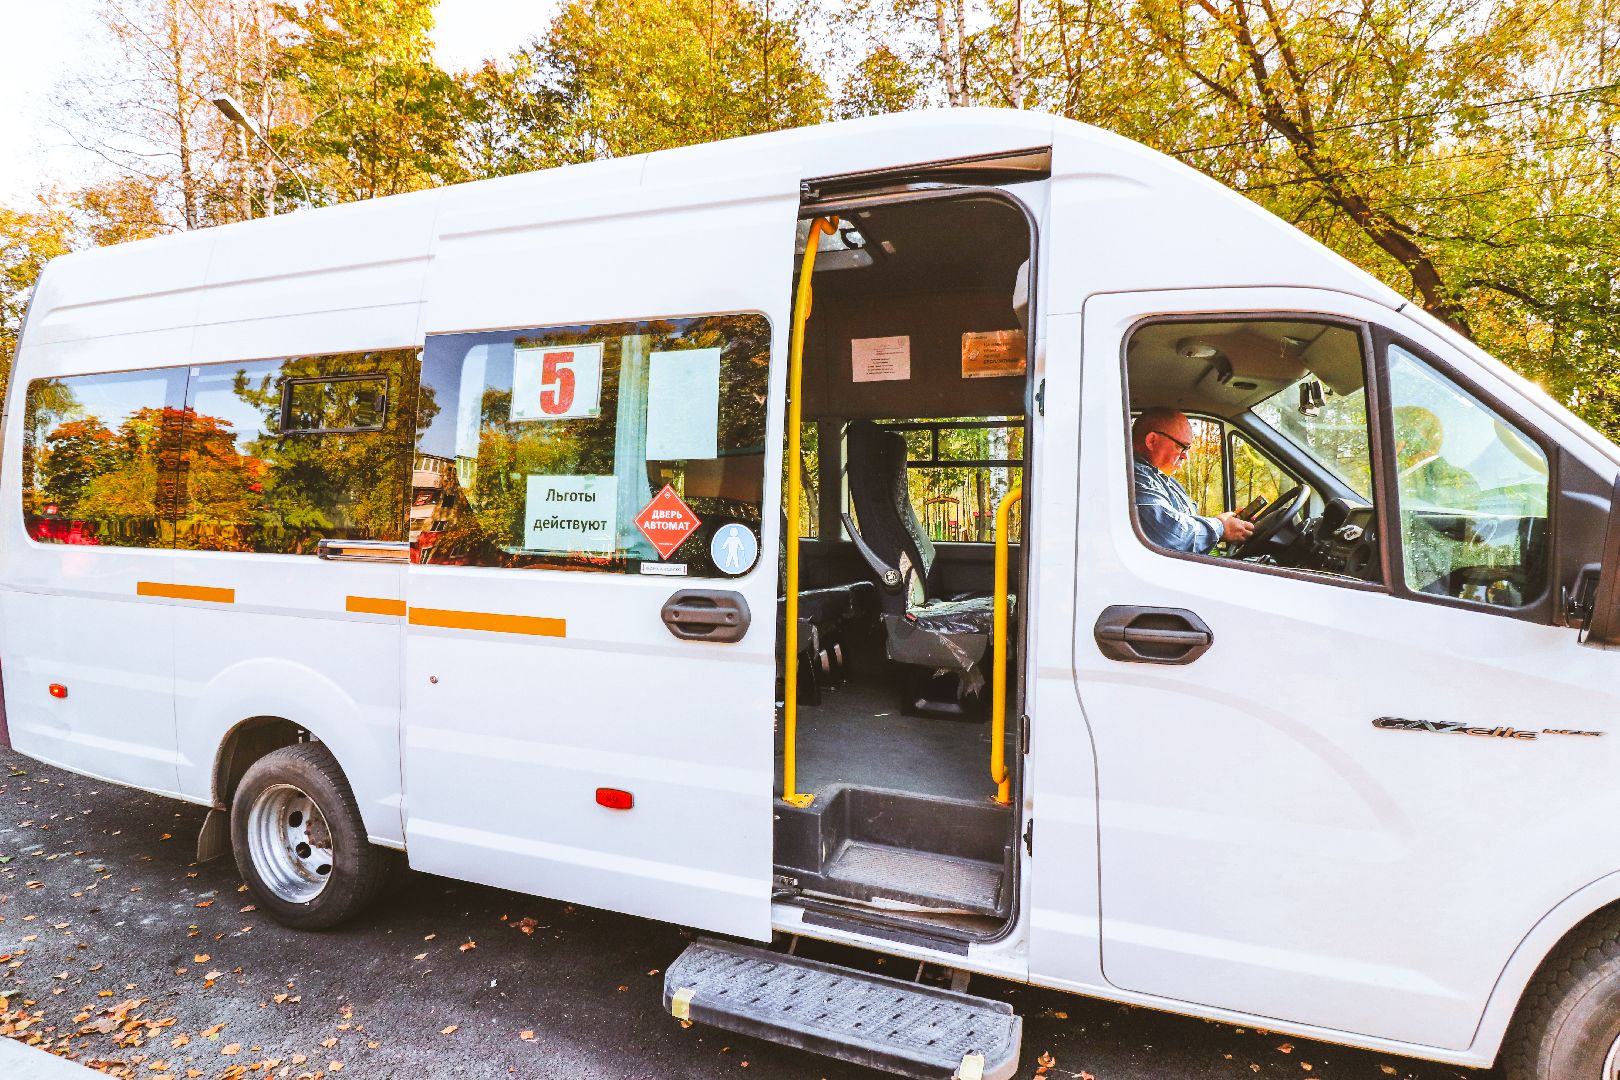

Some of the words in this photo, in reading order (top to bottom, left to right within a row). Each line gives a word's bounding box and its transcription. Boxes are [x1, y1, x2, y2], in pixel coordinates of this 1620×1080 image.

[539, 351, 576, 415] 5
[545, 488, 596, 503] Льготы
[651, 509, 683, 520] ДВЕРЬ
[533, 515, 608, 532] действуют
[643, 520, 691, 531] АВТОМАТ
